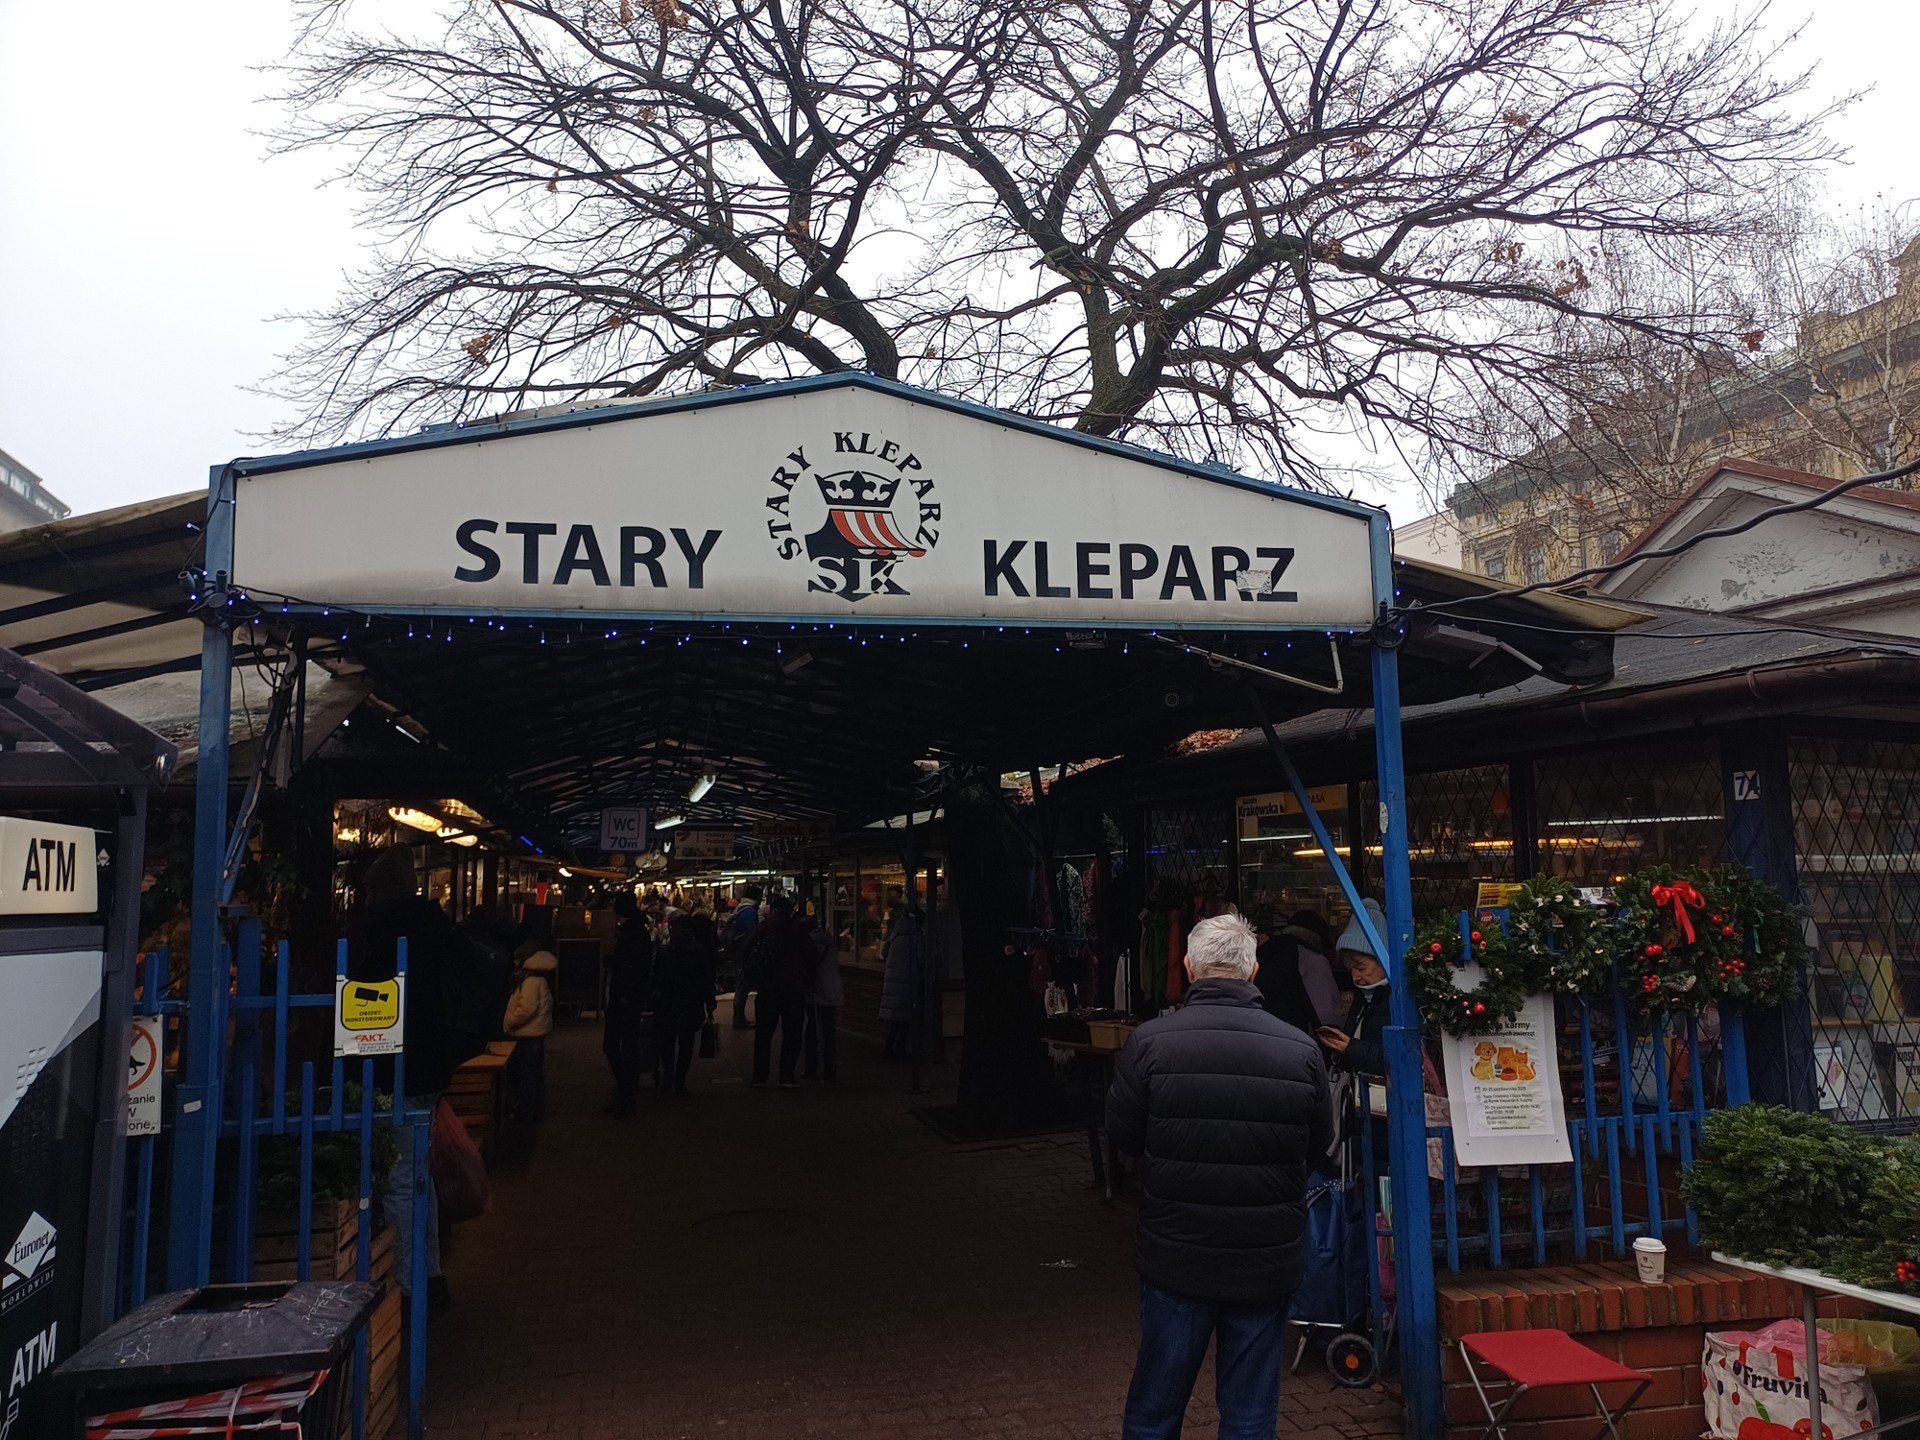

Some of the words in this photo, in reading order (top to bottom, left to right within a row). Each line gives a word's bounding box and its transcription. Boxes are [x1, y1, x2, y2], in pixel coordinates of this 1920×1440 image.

[766, 444, 812, 562] STARY
[833, 431, 941, 550] KLEPARZ
[454, 519, 723, 591] STARY
[985, 541, 1298, 602] KLEPARZ
[613, 818, 636, 832] WC
[1238, 803, 1279, 818] Krakowska
[22, 837, 76, 892] ATM
[610, 836, 639, 850] 70m
[13, 1231, 51, 1265] Euronet
[1, 1268, 56, 1311] WORLDWIDE
[8, 1320, 59, 1399] ATM
